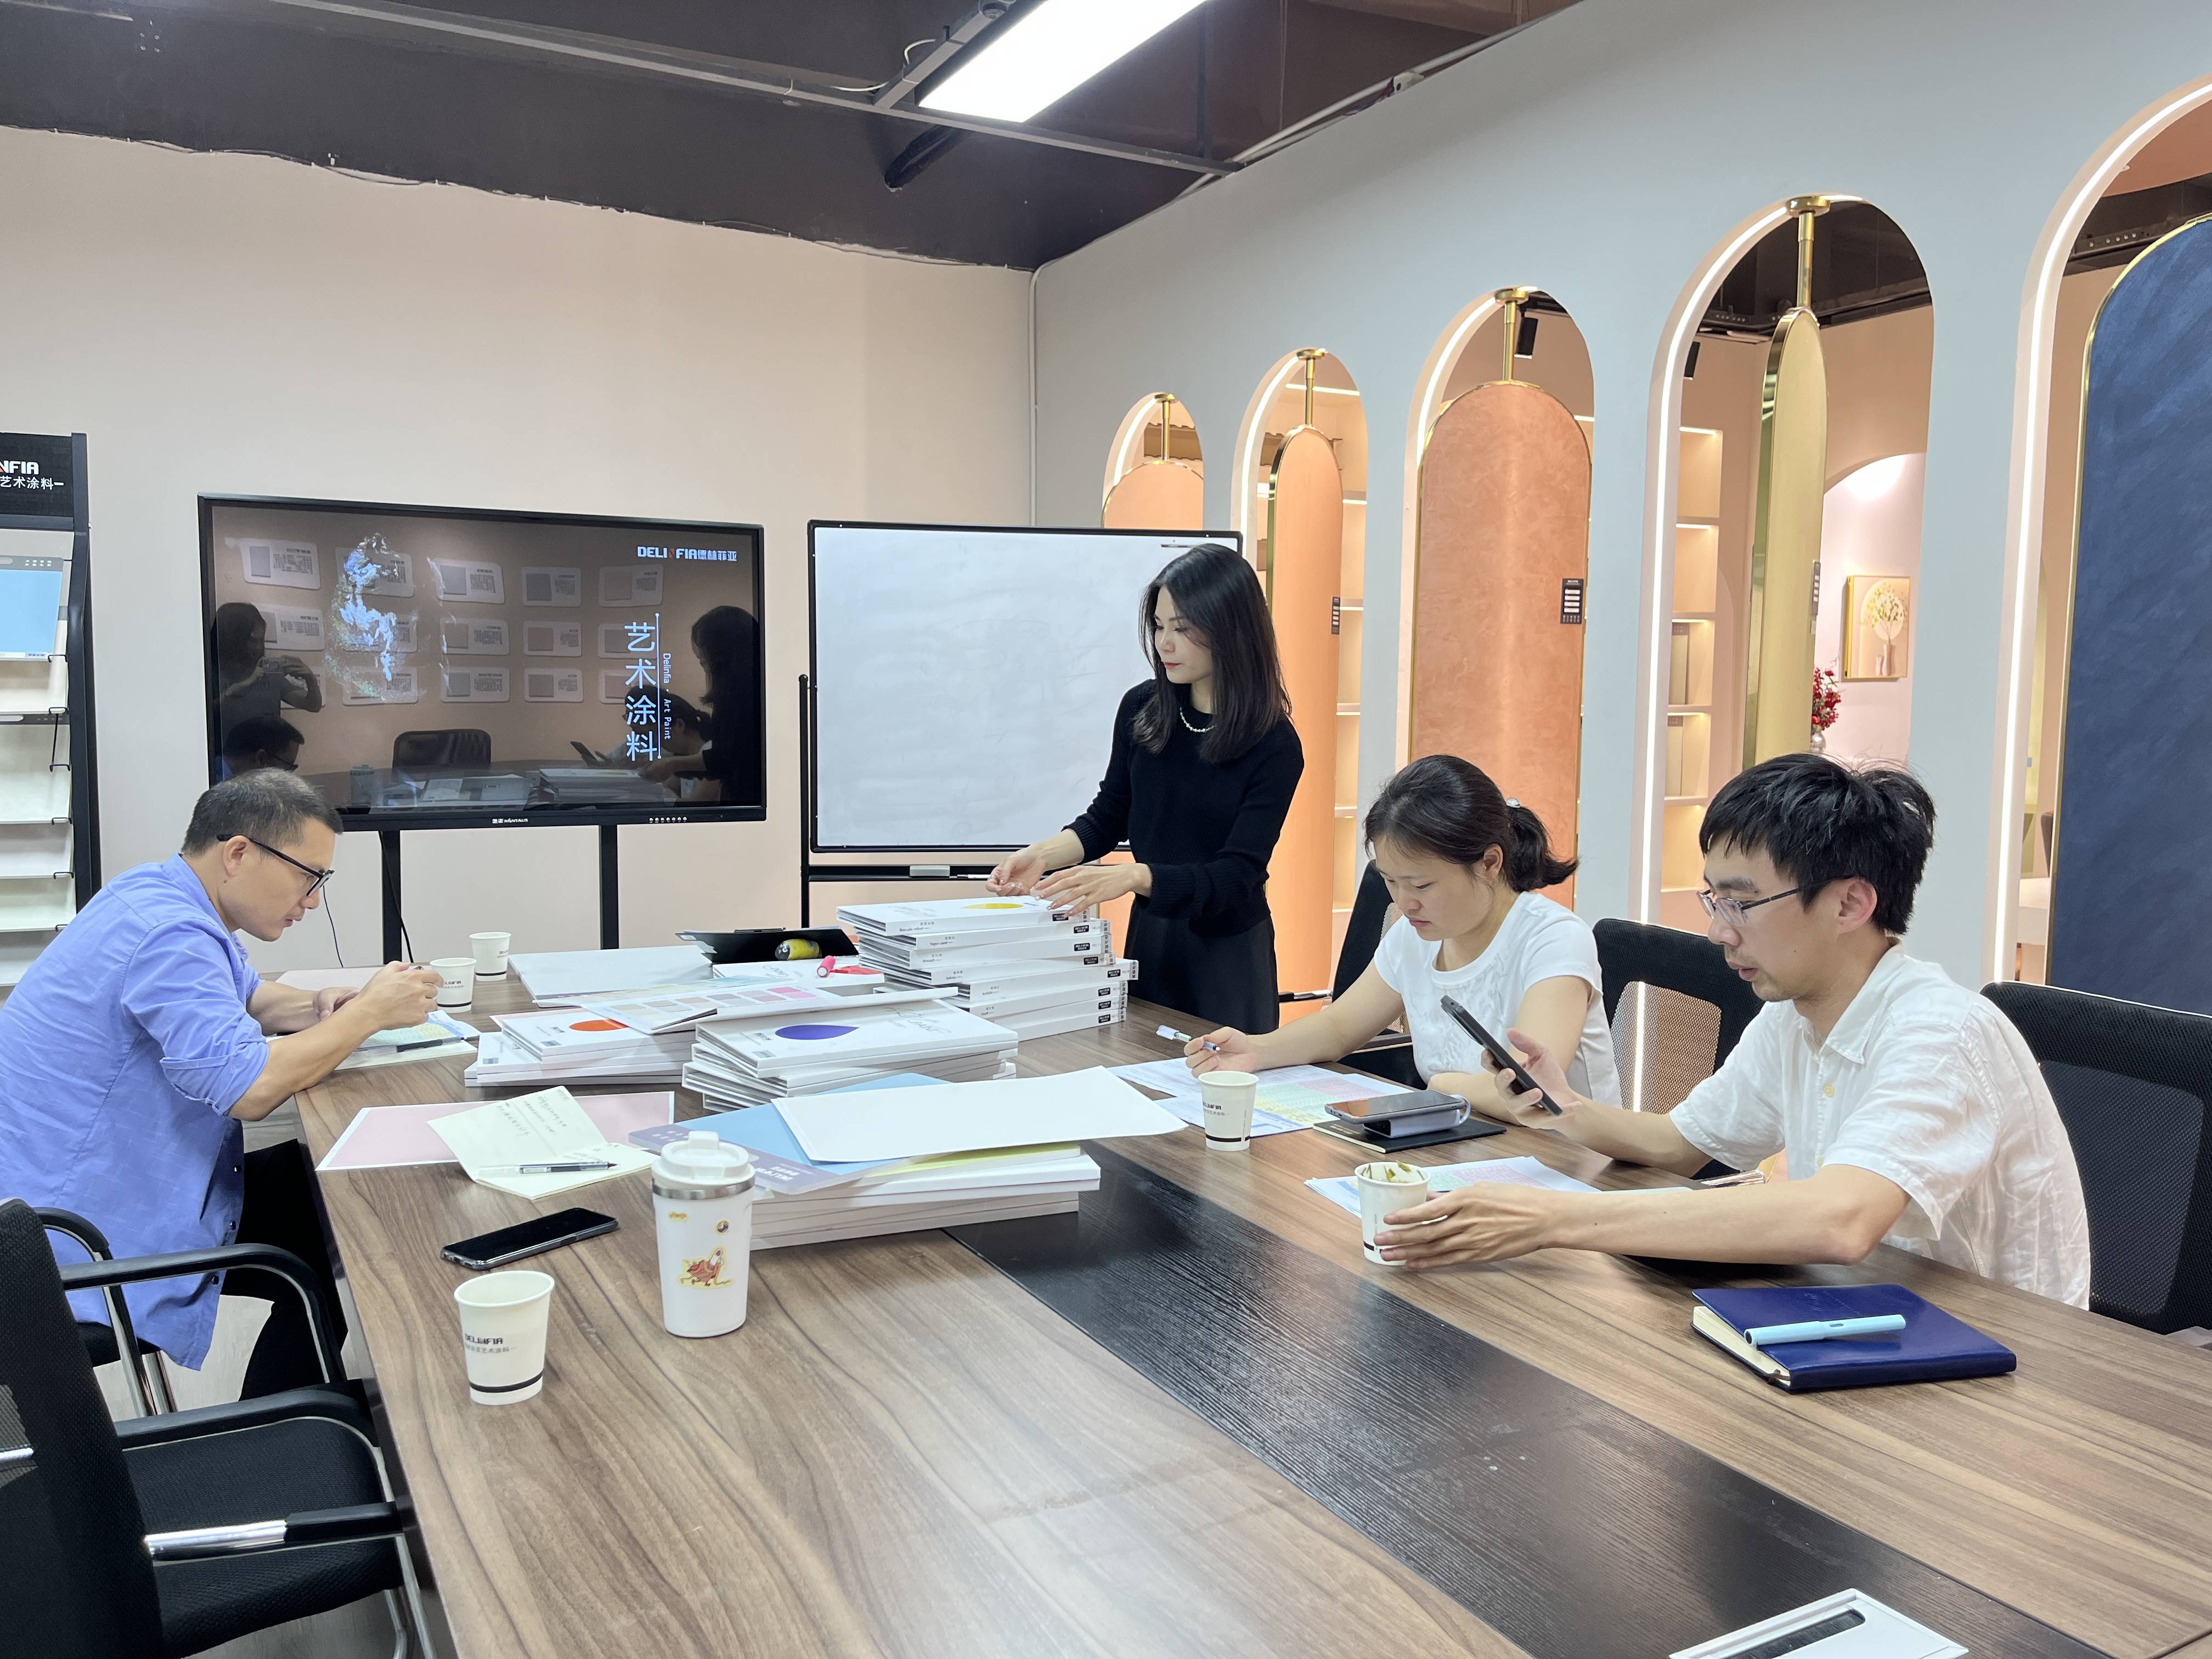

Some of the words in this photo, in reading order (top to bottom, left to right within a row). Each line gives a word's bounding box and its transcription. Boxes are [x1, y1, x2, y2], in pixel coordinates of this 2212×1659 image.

[663, 653, 672, 684] Delinfia
[624, 622, 657, 761] 艺术涂料
[663, 698, 672, 713] Art
[664, 716, 672, 740] Paint
